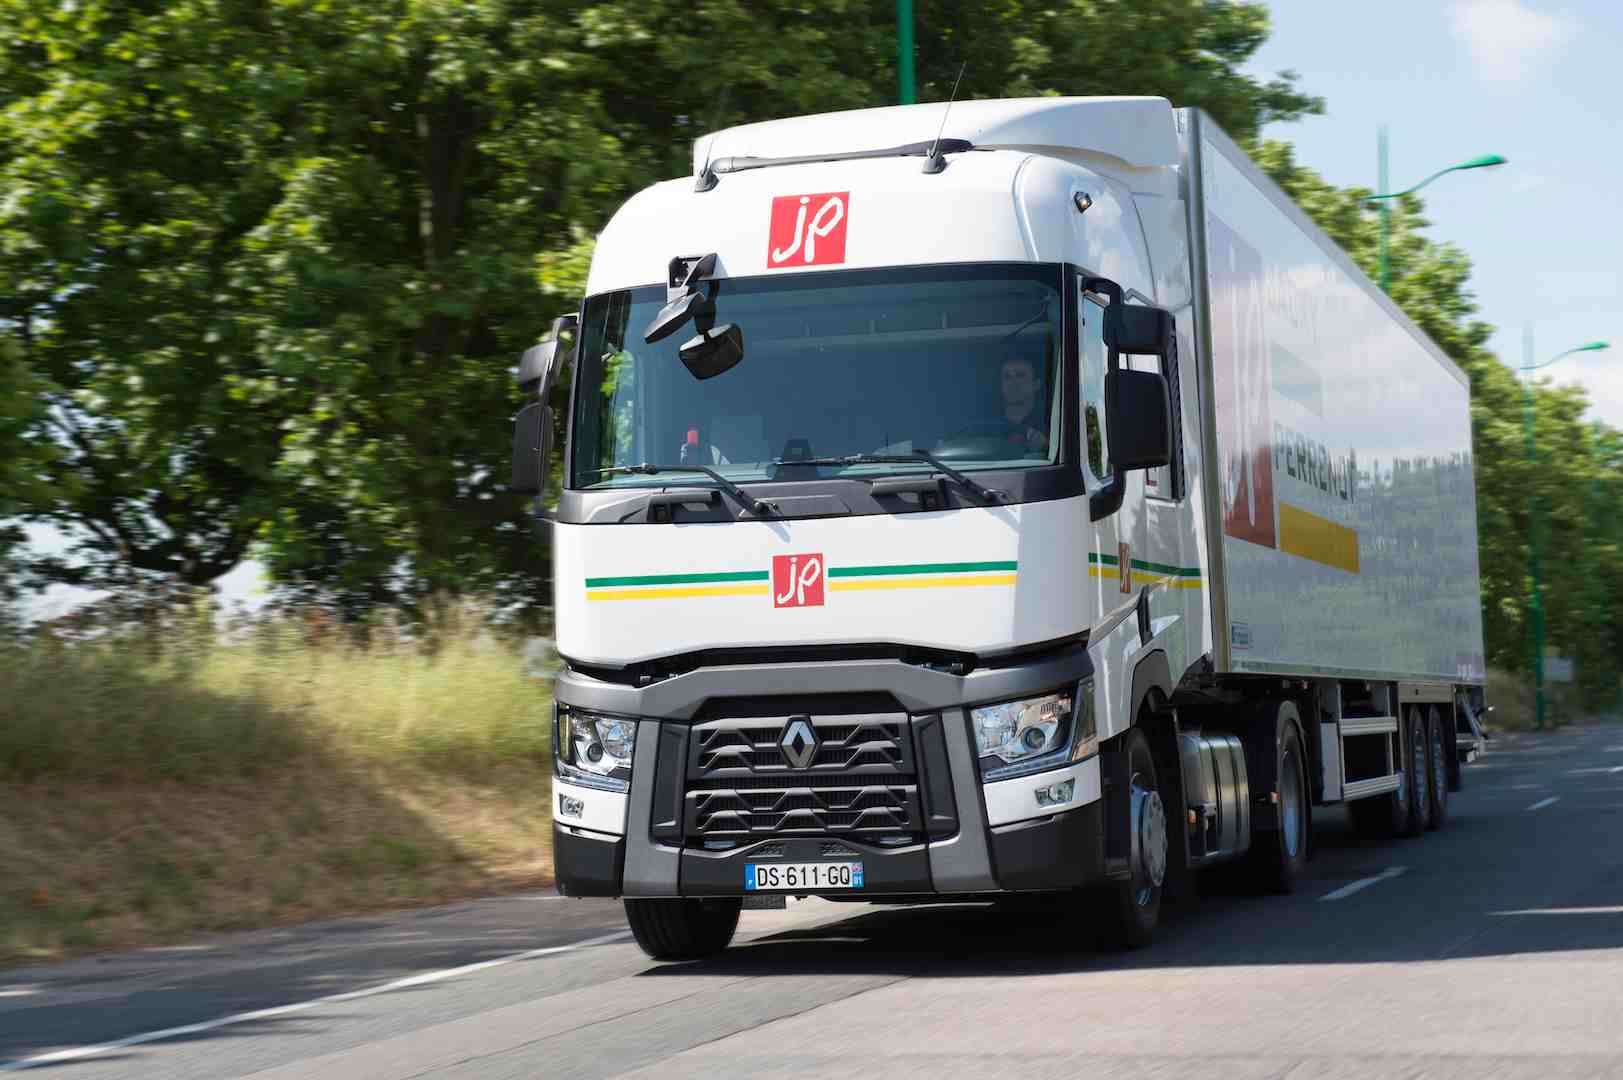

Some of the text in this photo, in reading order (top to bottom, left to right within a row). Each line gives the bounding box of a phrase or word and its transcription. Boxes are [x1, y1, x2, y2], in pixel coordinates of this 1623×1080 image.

[772, 196, 844, 264] jp
[777, 556, 821, 605] jp
[757, 866, 850, 887] DS-611-GQ
